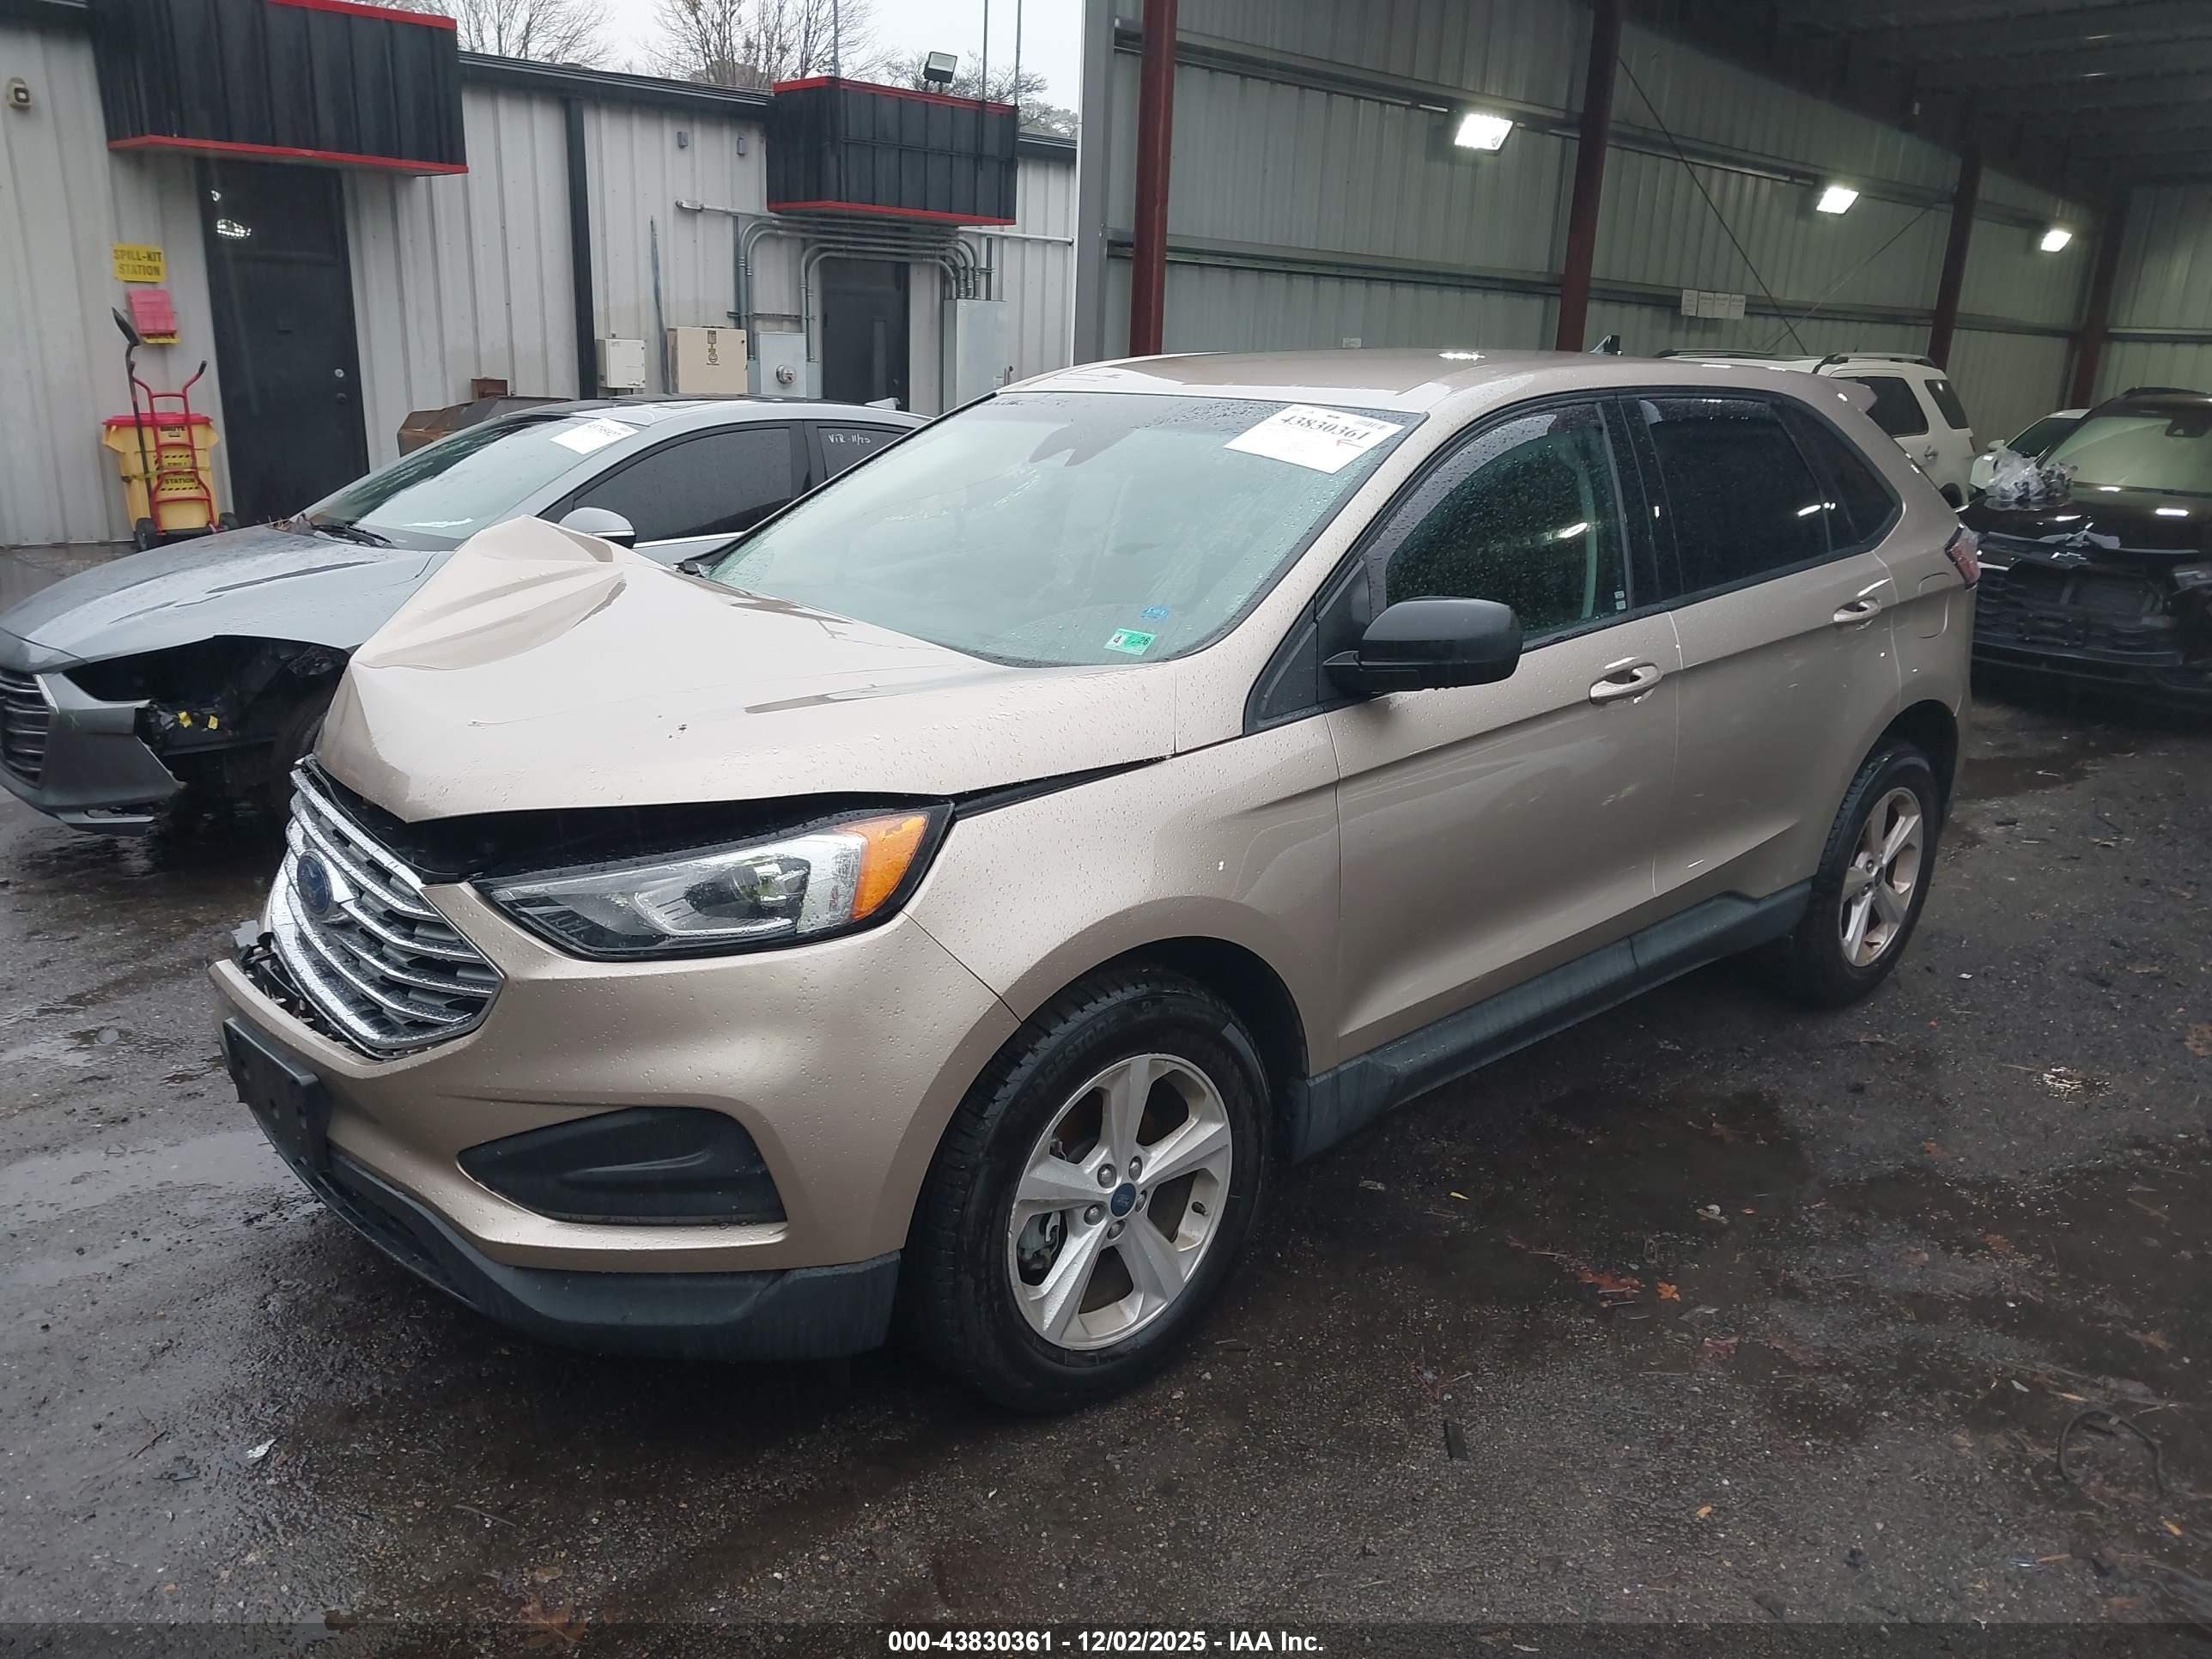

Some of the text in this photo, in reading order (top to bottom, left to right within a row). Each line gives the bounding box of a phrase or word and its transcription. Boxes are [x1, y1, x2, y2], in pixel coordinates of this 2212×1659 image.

[113, 249, 161, 262] SPILL-KIT
[118, 264, 160, 276] STATION
[1280, 416, 1370, 441] 43830361
